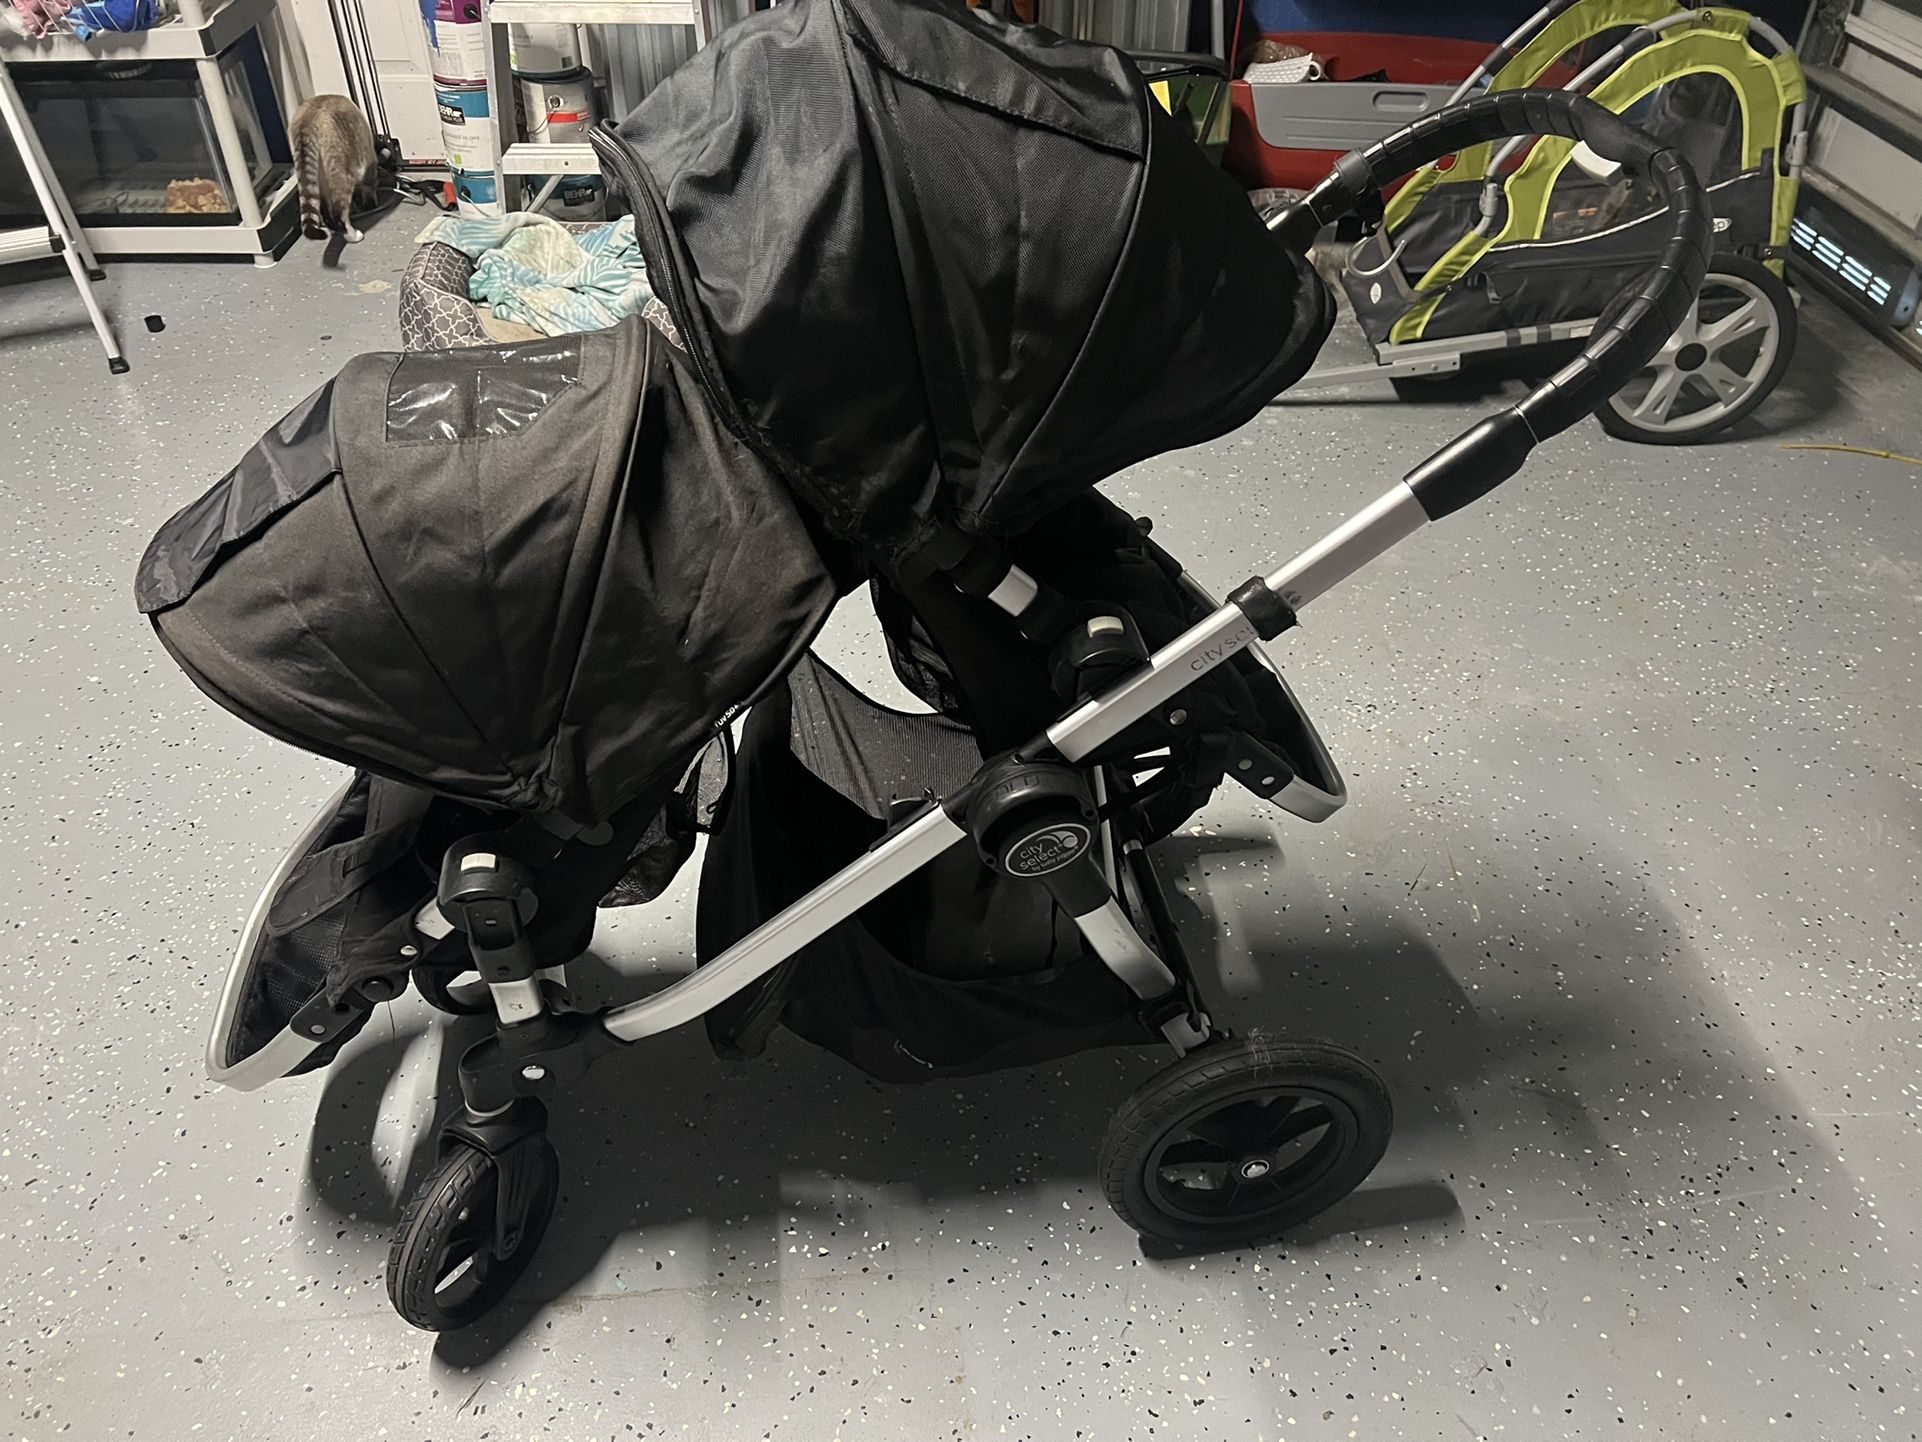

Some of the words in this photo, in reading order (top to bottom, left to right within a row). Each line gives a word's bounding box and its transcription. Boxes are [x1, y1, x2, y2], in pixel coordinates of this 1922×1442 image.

[1190, 643, 1224, 671] city
[1019, 845, 1062, 871] select
[1020, 843, 1043, 859] city
